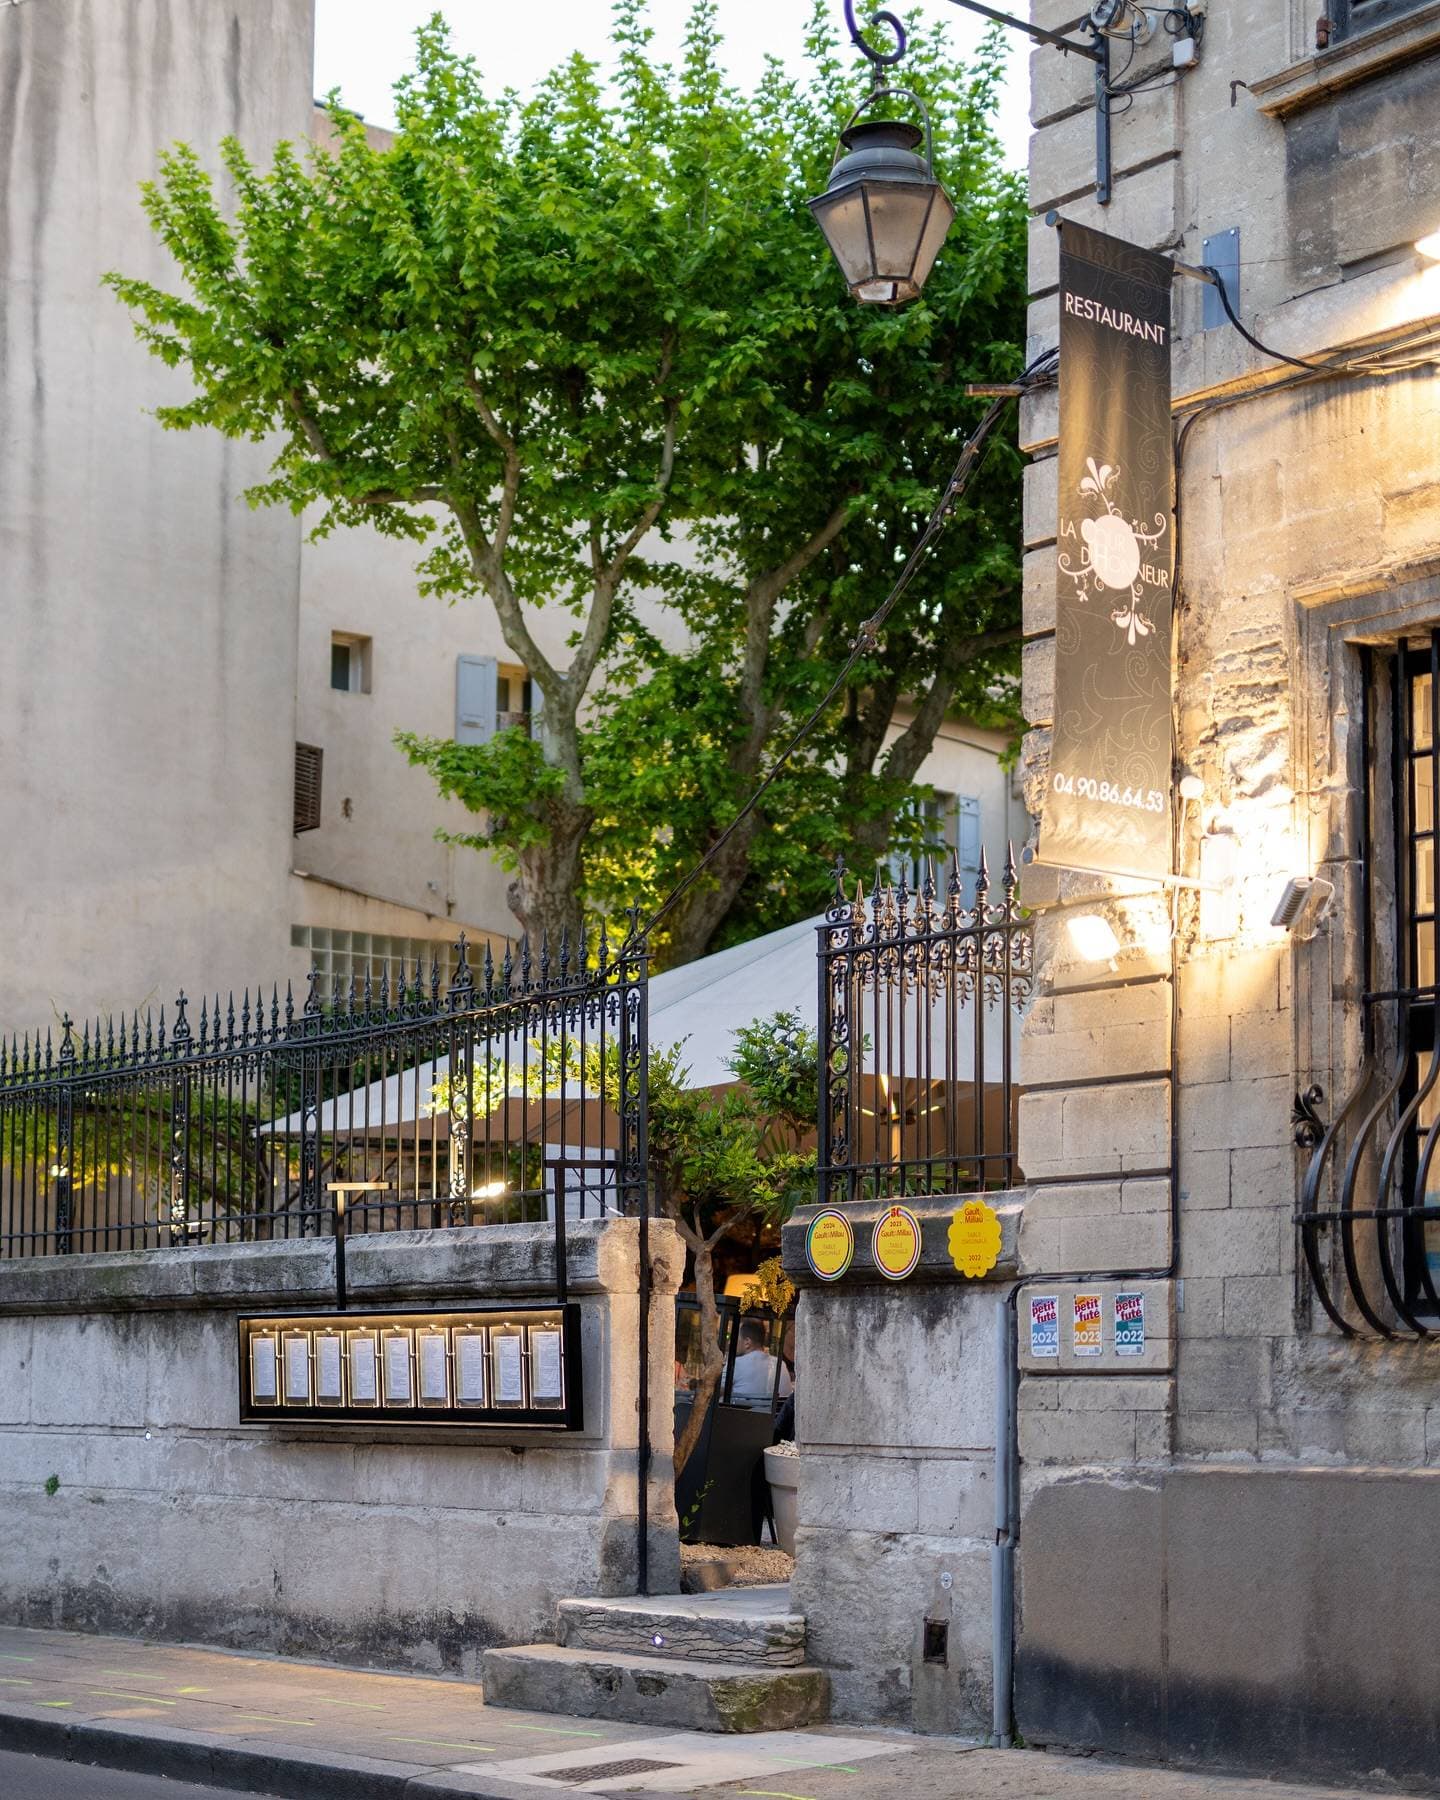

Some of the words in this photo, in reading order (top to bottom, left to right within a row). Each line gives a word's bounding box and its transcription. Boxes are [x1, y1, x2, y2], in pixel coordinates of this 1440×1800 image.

[1065, 292, 1165, 345] RESTAURANT
[1061, 518, 1077, 539] LA
[1053, 772, 1164, 812] 04.90.86.64.53
[964, 1215, 984, 1223] Millau
[1032, 1301, 1055, 1317] petit
[1075, 1299, 1099, 1315] petit
[1115, 1297, 1141, 1314] petit
[1037, 1311, 1057, 1324] futé
[1079, 1309, 1100, 1321] futé
[1121, 1308, 1142, 1321] futé
[1033, 1332, 1057, 1343] 2024
[1075, 1331, 1100, 1343] 2023
[1116, 1331, 1143, 1342] 2022
